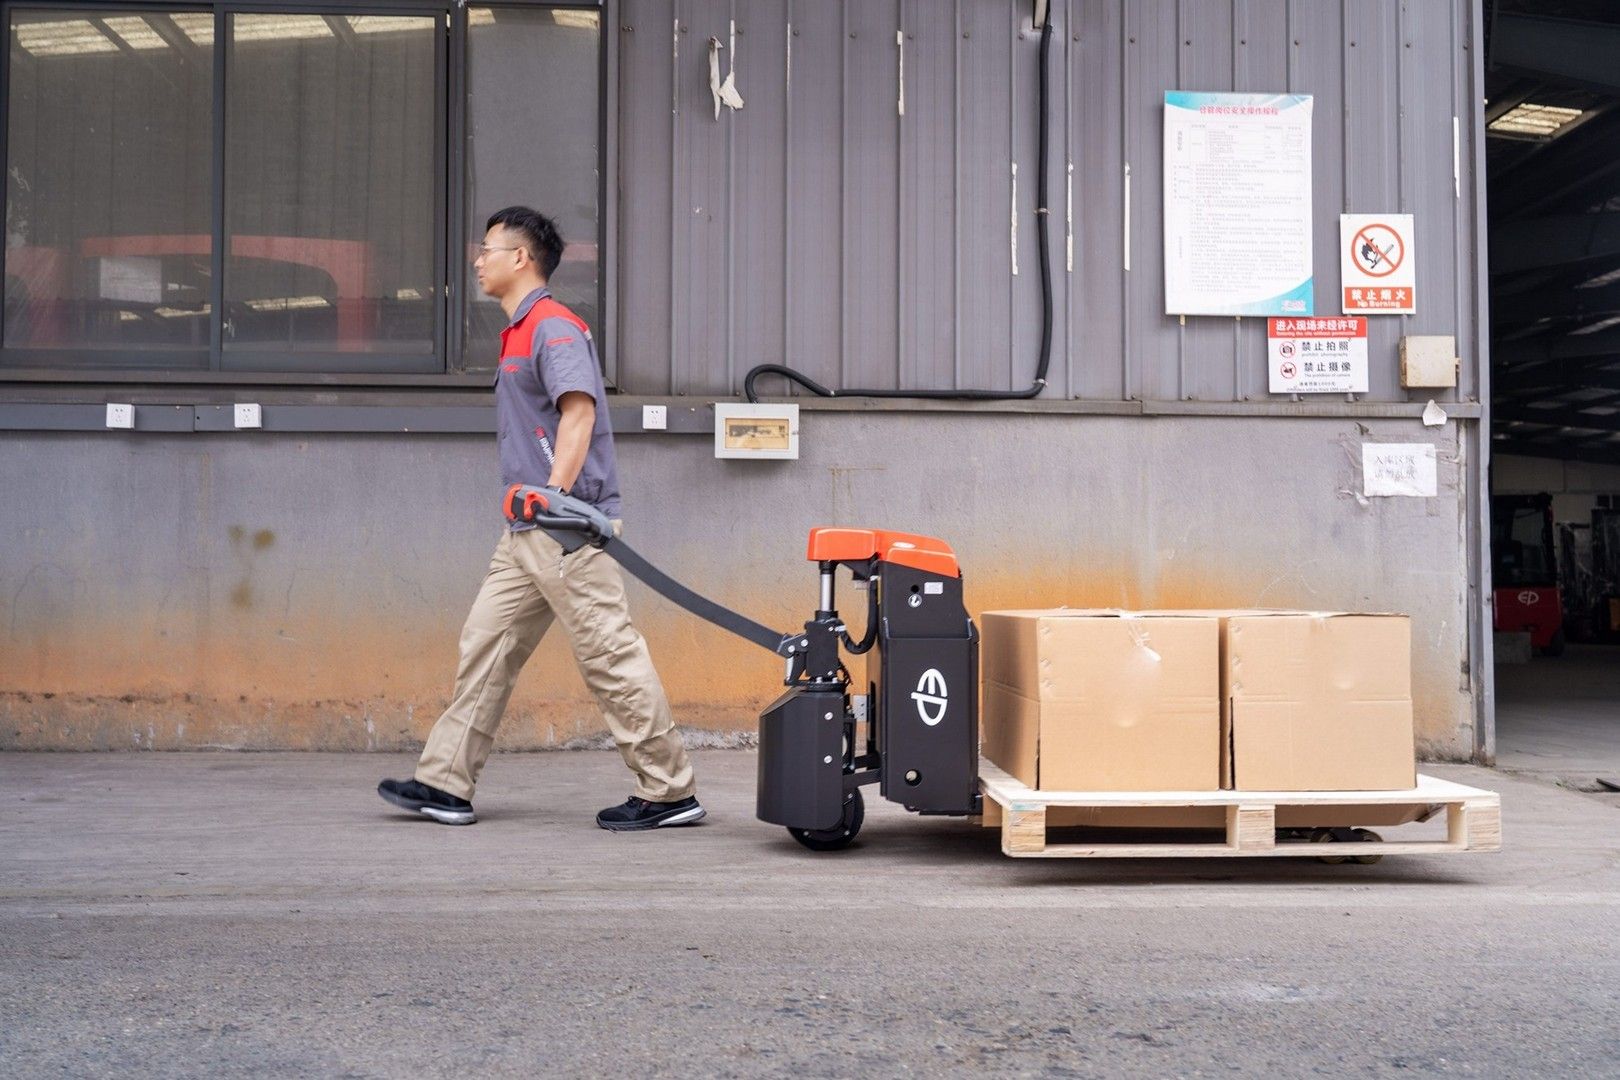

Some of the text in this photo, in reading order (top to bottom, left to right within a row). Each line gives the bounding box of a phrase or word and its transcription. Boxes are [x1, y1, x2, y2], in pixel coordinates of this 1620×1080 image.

[1351, 288, 1406, 301] 禁止烟火
[1369, 300, 1401, 308] Burning
[1276, 319, 1358, 331] 进入现场未经许可
[1302, 341, 1349, 352] 禁止拍照
[1304, 361, 1351, 372] 禁止摄像
